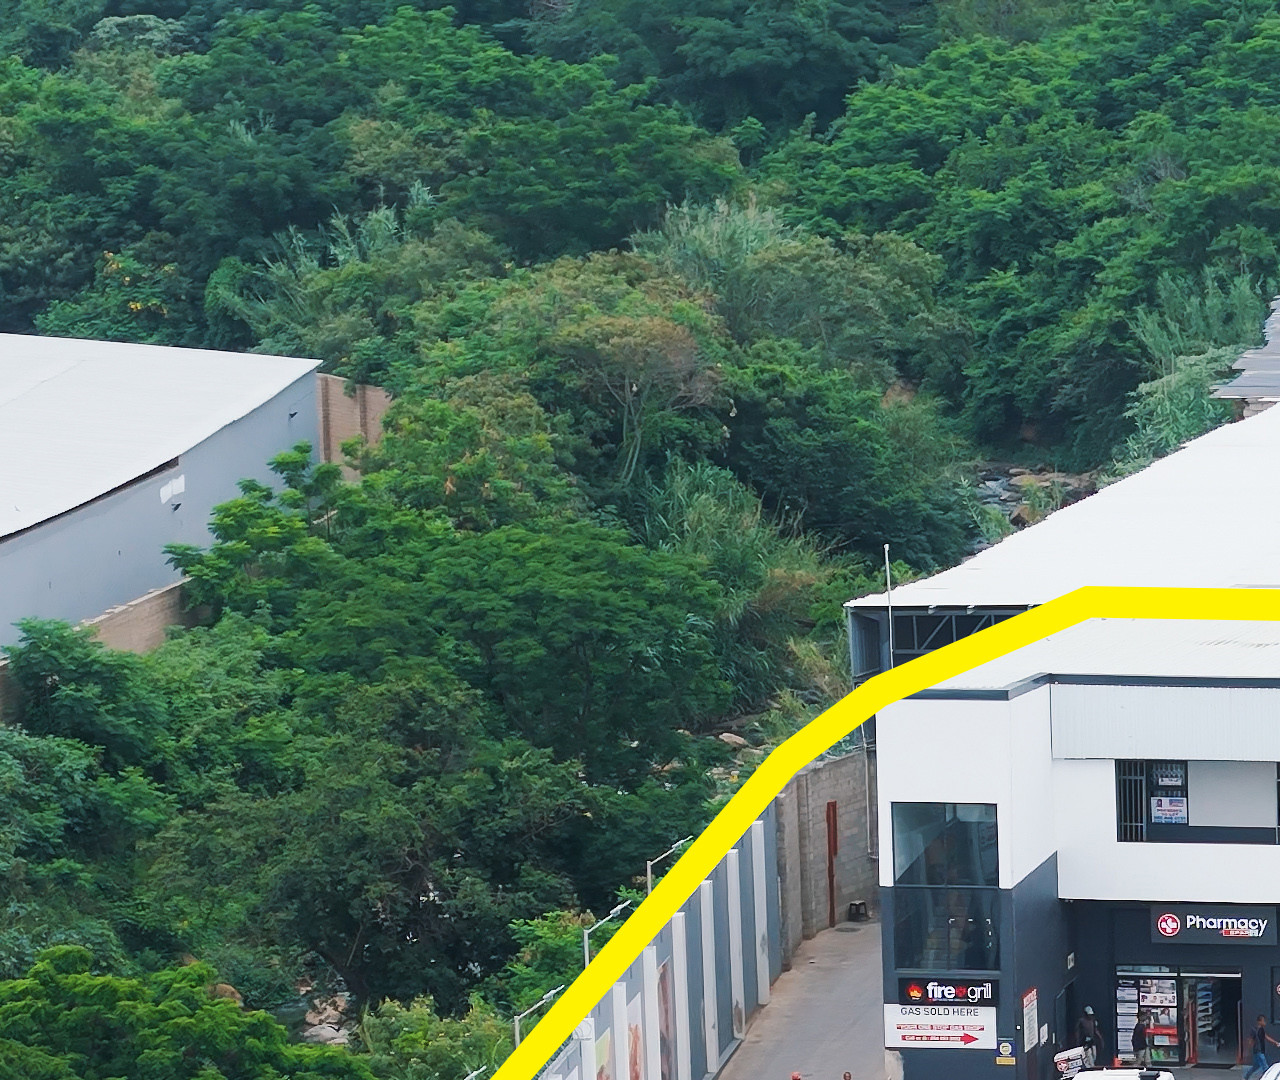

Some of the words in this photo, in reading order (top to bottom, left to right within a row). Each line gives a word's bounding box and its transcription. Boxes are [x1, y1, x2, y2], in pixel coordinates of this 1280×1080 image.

[1186, 915, 1268, 936] Pharmacy
[926, 982, 956, 999] fire
[967, 983, 992, 1002] grill
[900, 1007, 921, 1016] GAS
[923, 1008, 950, 1016] SOLD
[952, 1008, 979, 1016] HERE
